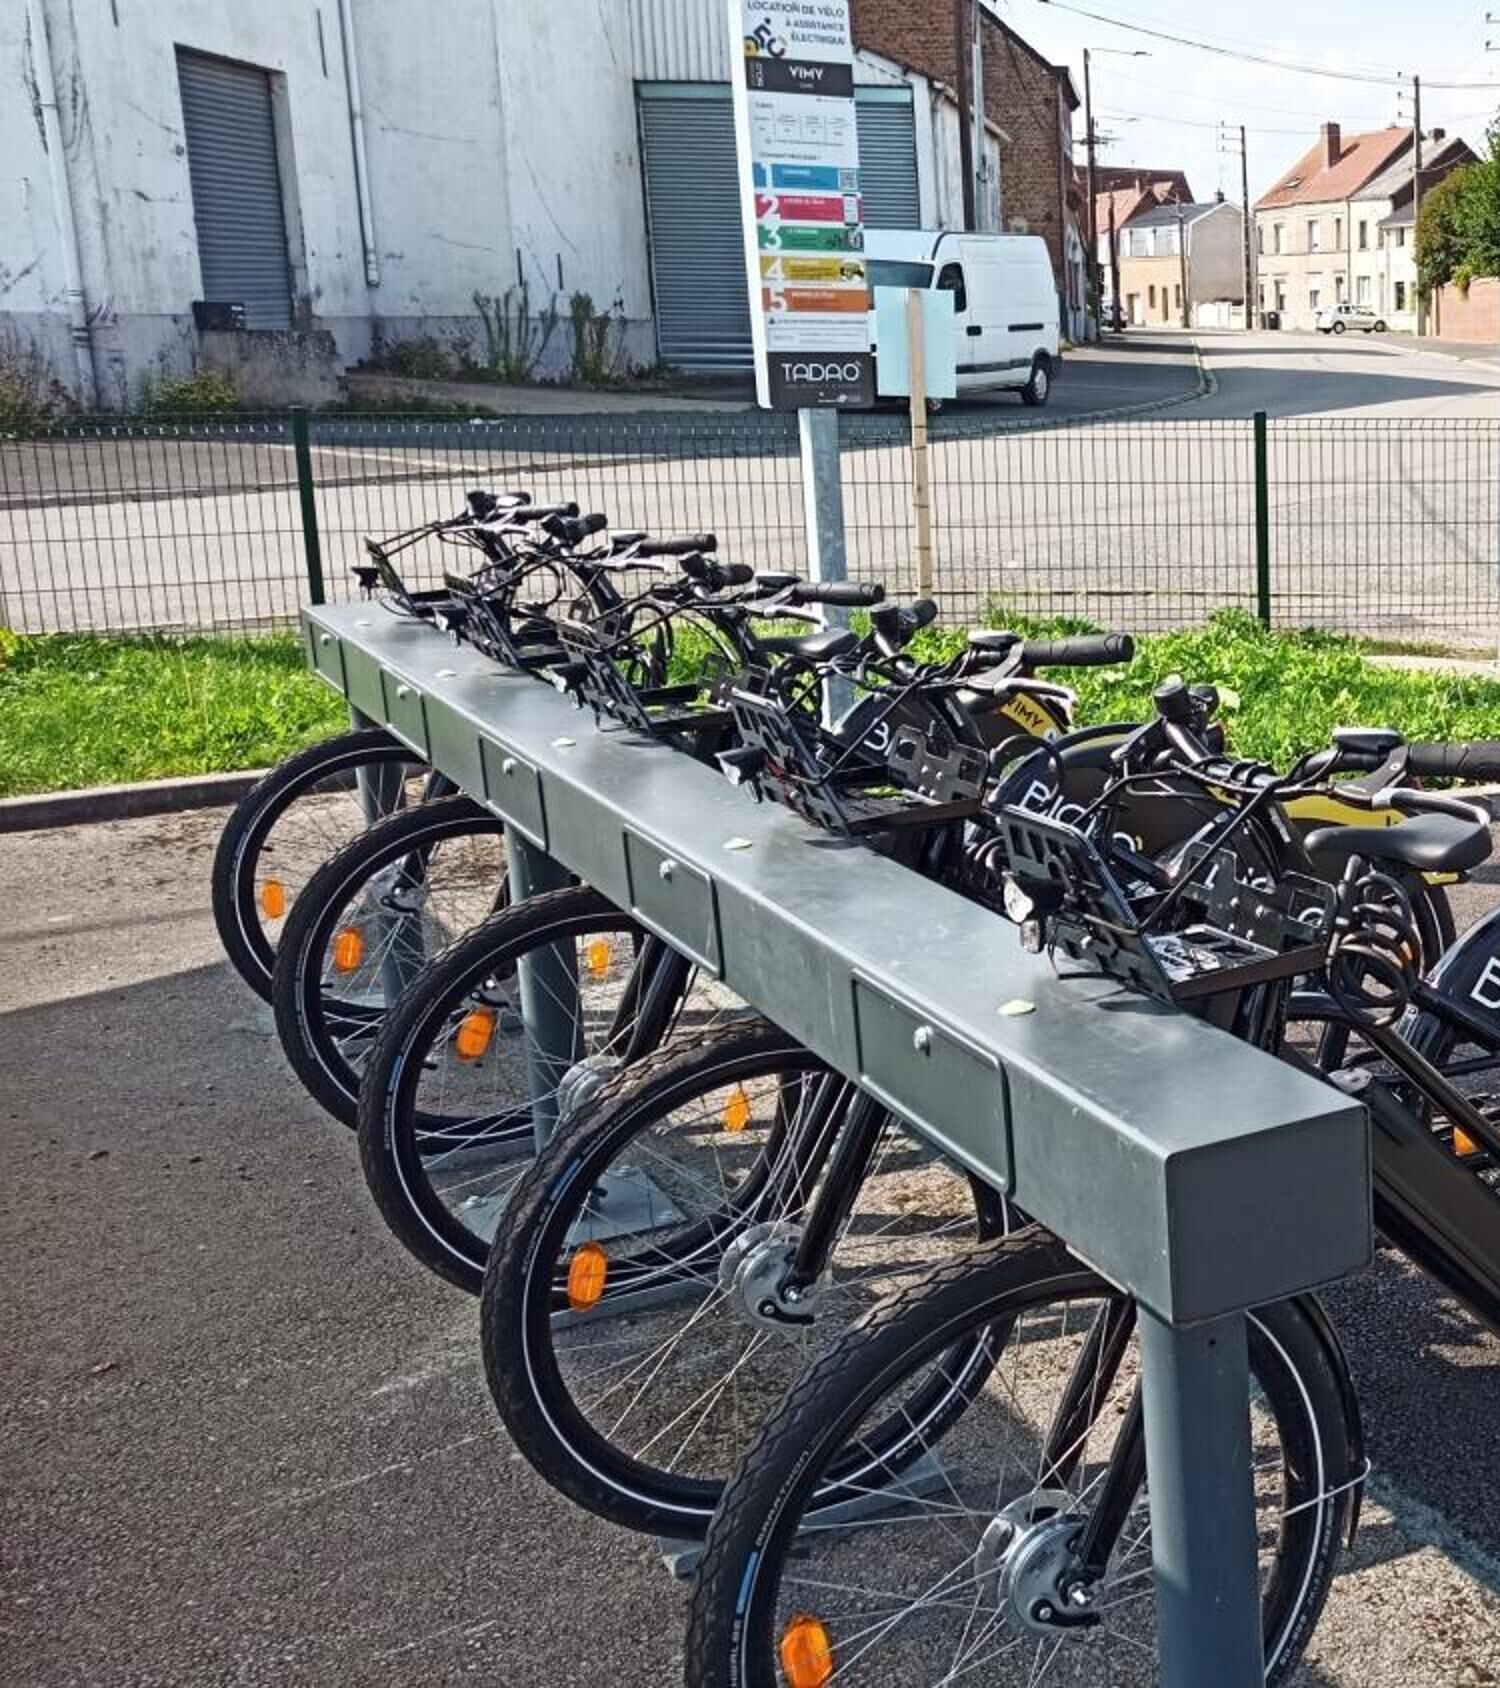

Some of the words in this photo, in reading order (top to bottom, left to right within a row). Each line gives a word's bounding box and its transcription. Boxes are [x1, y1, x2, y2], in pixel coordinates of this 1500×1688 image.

[747, 1, 800, 13] LOCATION
[802, 5, 815, 15] DE
[789, 65, 824, 80] VIMY
[761, 195, 780, 221] 2
[763, 221, 783, 249] 3
[765, 257, 785, 283] 4
[769, 284, 788, 312] 5
[1007, 700, 1045, 728] IMY
